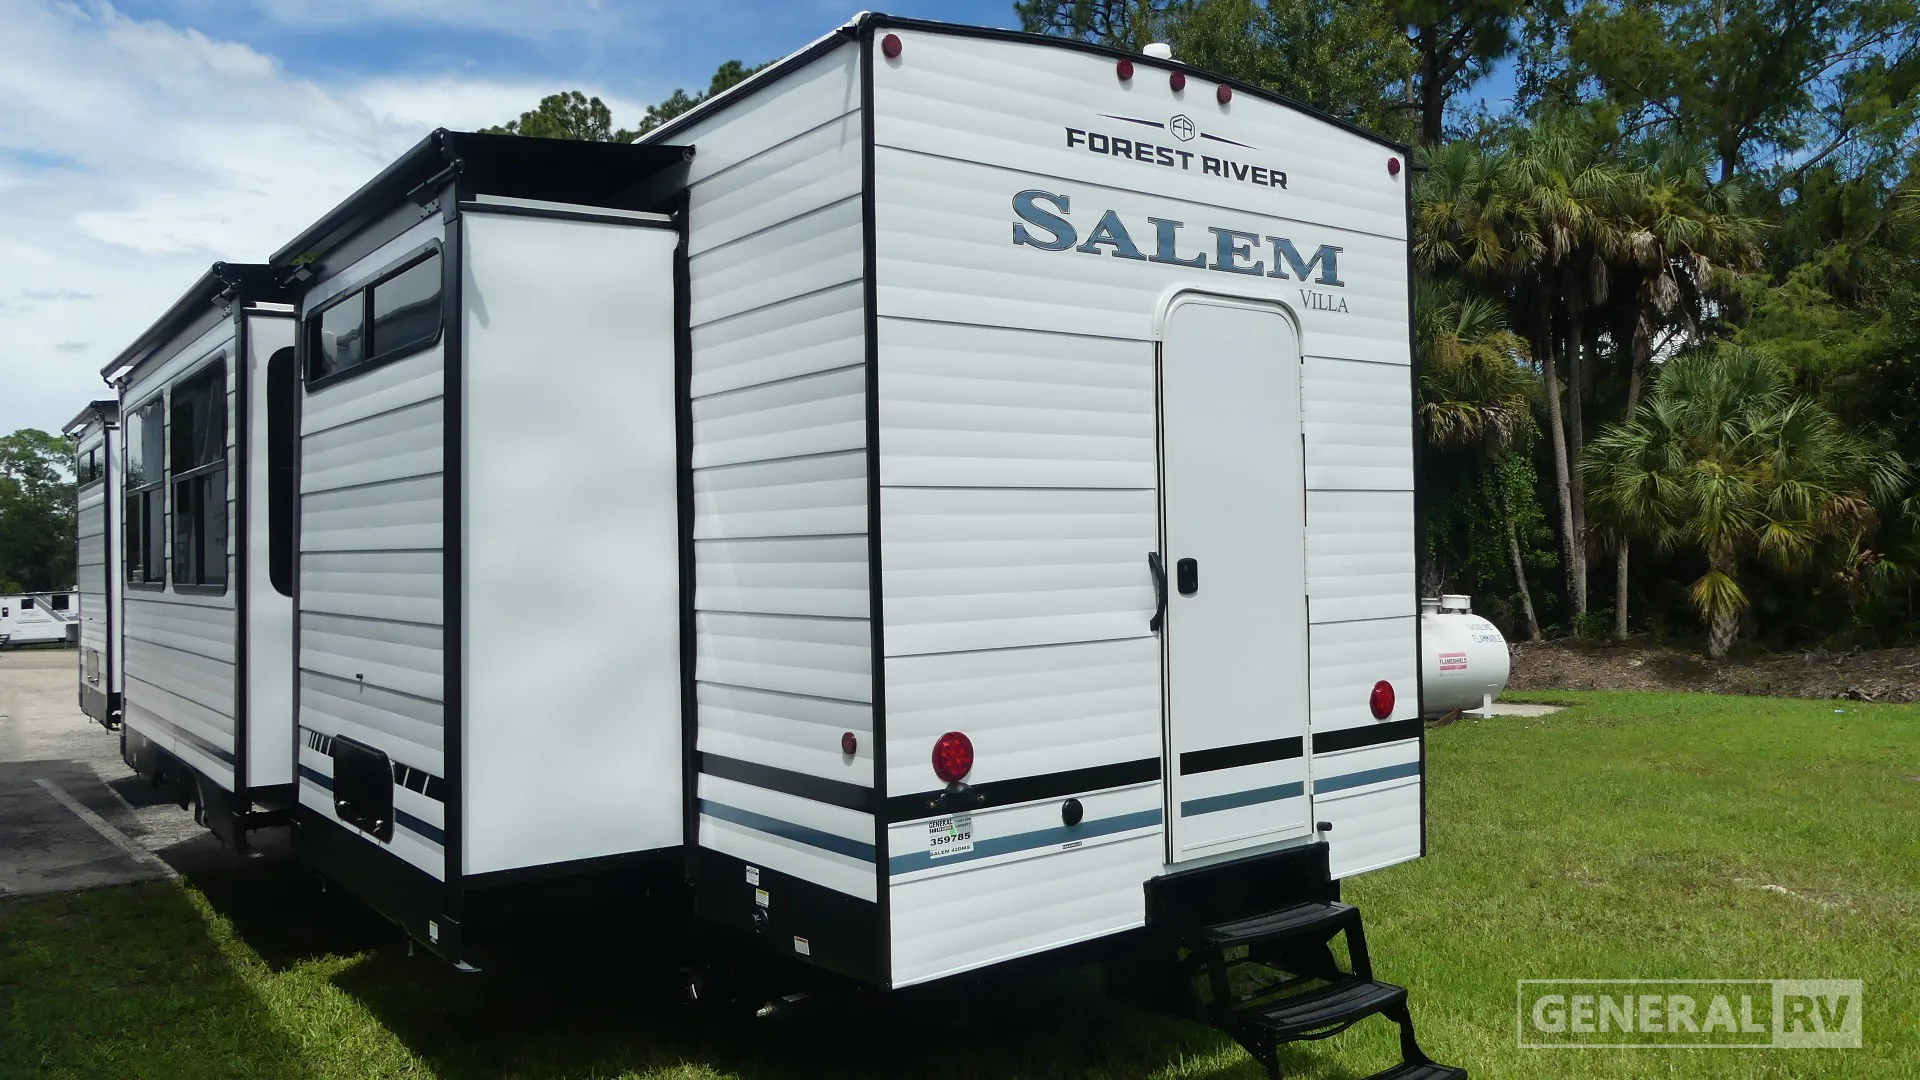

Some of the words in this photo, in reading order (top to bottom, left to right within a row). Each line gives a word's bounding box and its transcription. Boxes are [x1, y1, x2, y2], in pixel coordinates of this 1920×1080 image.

[1065, 127, 1194, 170] FOREST
[1200, 155, 1288, 189] RIVER
[1012, 188, 1345, 287] SALEM
[1299, 288, 1349, 314] VILLA
[1439, 657, 1467, 665] FLAMESHIELD
[928, 818, 954, 829] GENERAL
[930, 831, 971, 847] 359785
